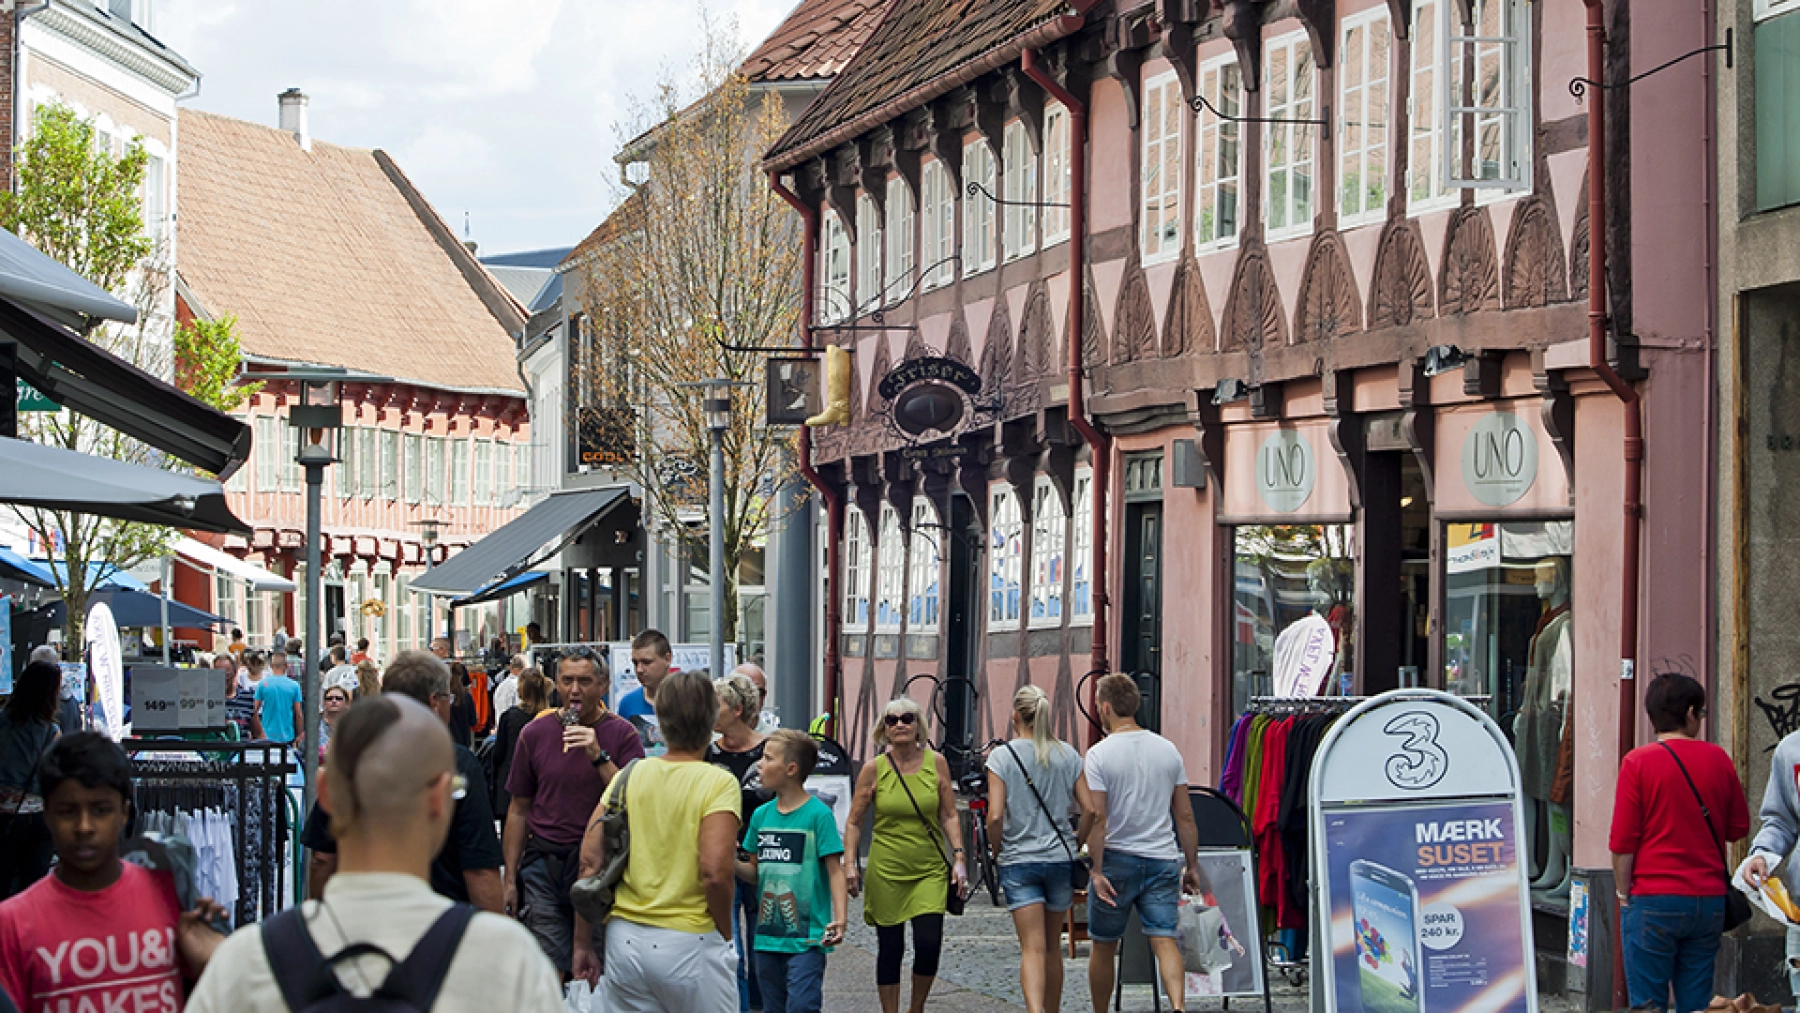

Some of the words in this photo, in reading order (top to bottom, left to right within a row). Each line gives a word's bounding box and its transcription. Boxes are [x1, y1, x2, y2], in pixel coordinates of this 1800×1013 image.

[1265, 443, 1305, 488] UNO
[1474, 427, 1523, 478] UNO
[1383, 710, 1449, 790] 3
[1414, 818, 1504, 843] MÆRK
[1417, 841, 1505, 867] SUSET
[1424, 913, 1456, 925] SPAR
[1421, 928, 1443, 938] 240
[1445, 927, 1460, 937] kr.
